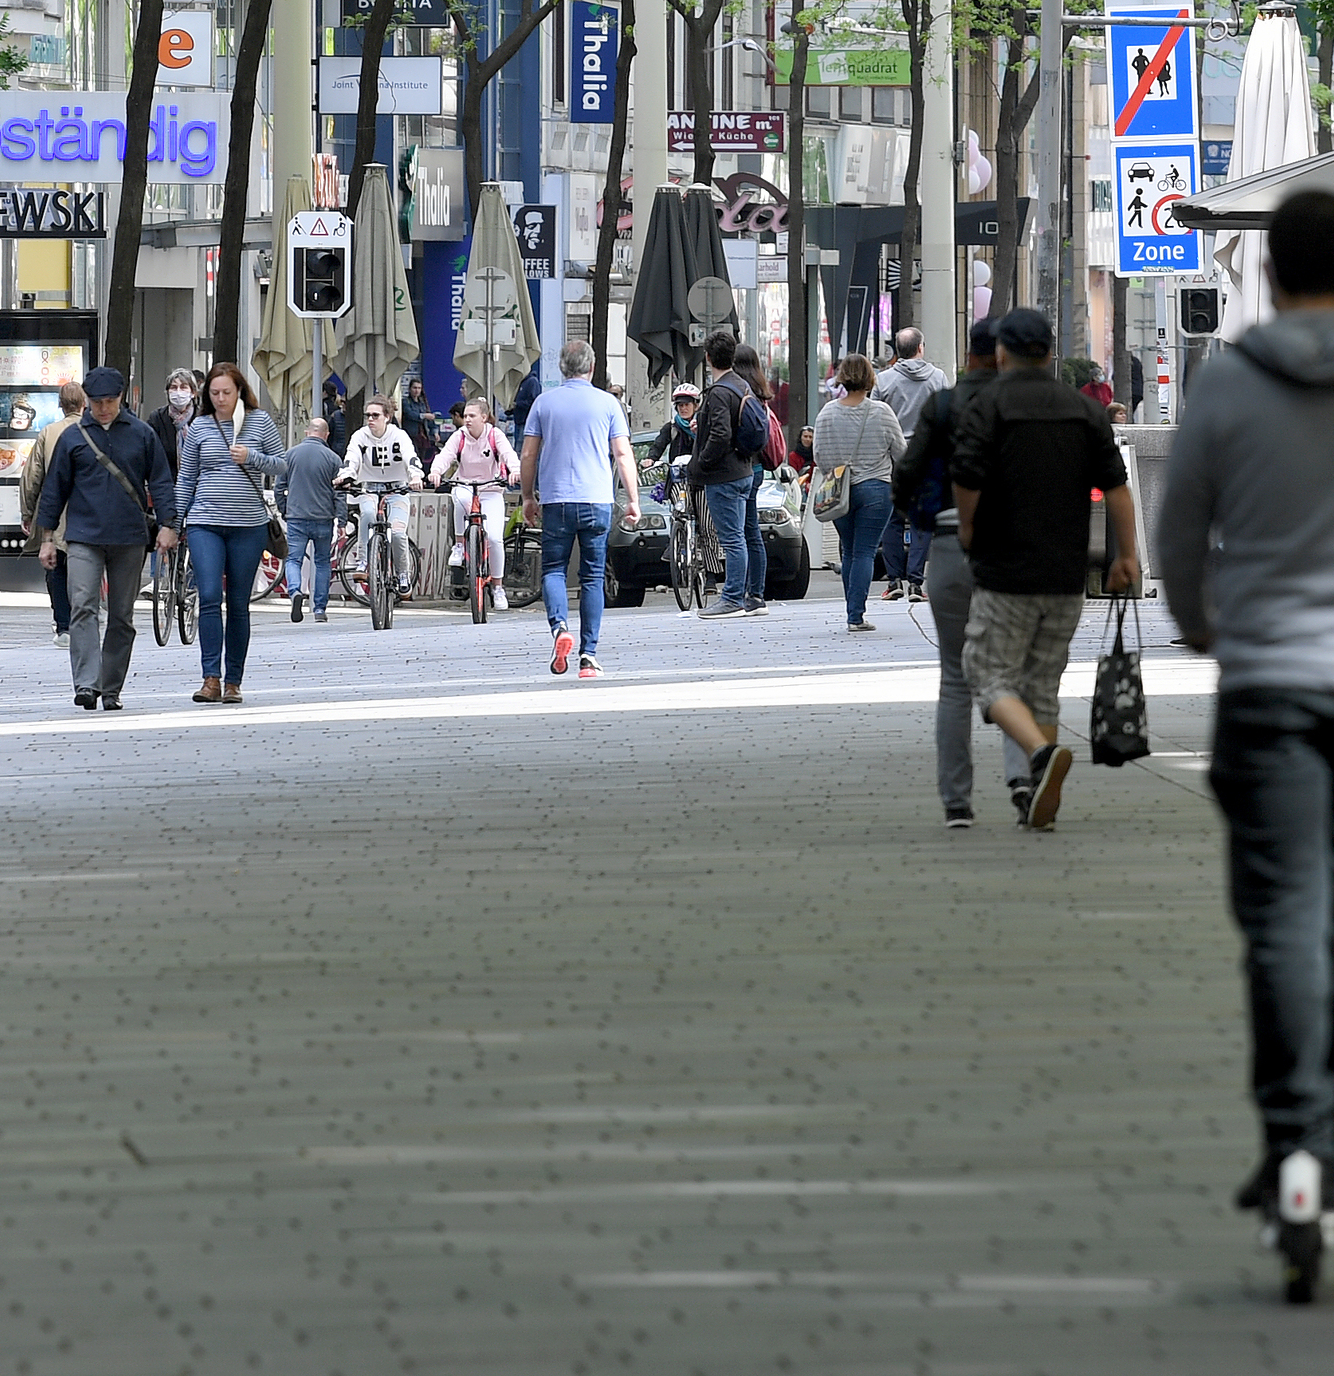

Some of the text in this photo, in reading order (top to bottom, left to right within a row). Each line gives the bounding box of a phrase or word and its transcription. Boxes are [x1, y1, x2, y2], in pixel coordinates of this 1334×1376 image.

[582, 13, 609, 110] Thalia
[332, 80, 354, 90] Joint
[667, 113, 752, 130] ANINE
[673, 131, 714, 140] Wier
[718, 129, 754, 141] Küche
[418, 166, 451, 227] Thalia
[1133, 241, 1186, 261] Zone
[522, 258, 550, 271] FFEE
